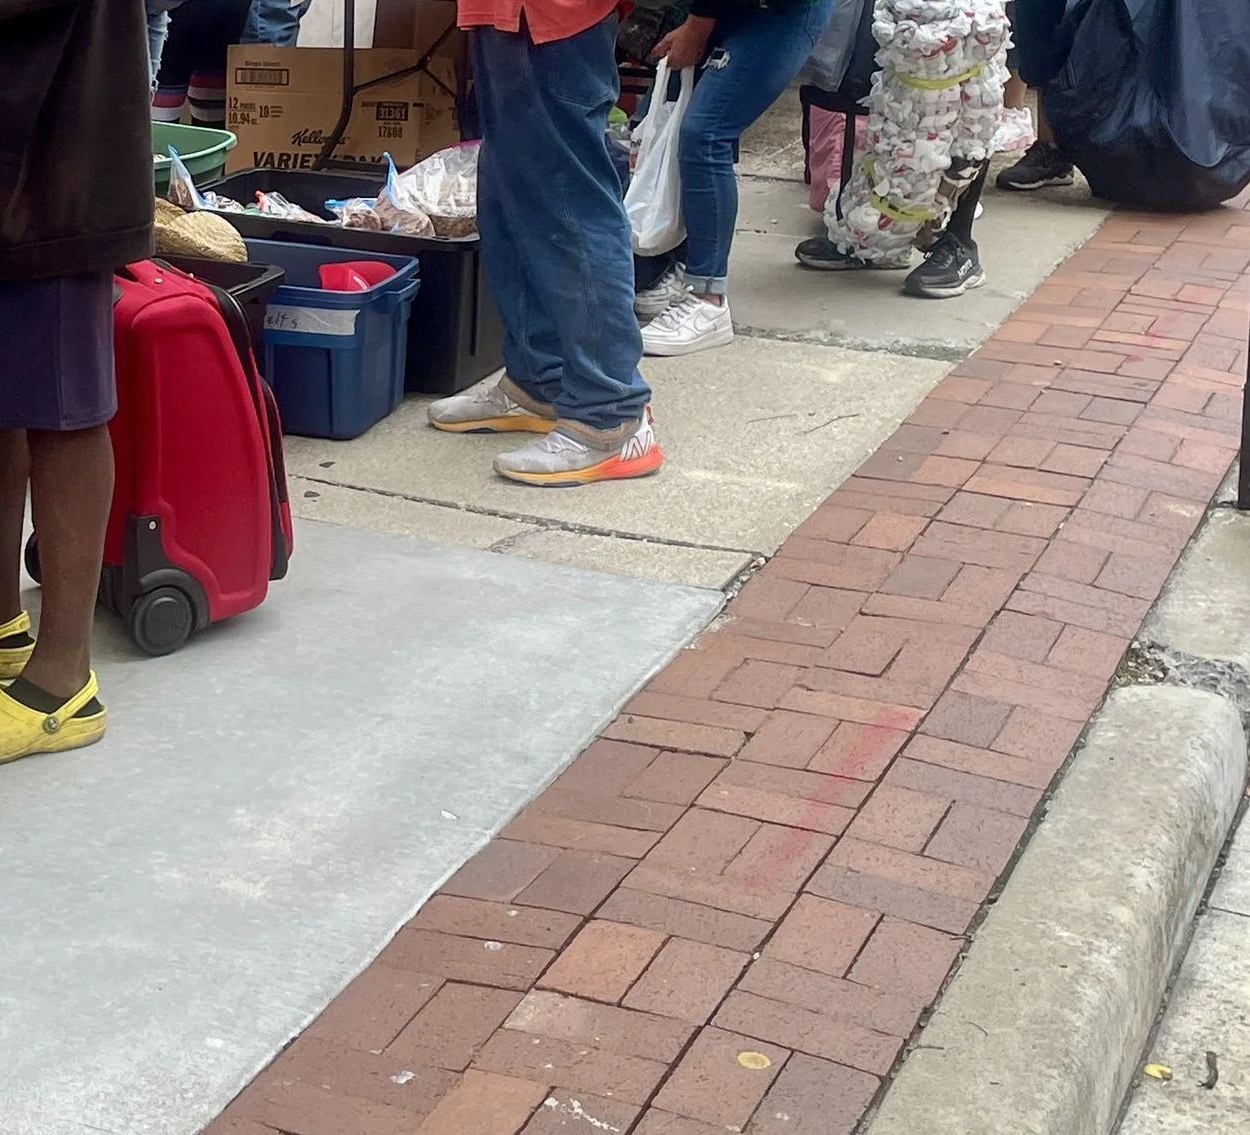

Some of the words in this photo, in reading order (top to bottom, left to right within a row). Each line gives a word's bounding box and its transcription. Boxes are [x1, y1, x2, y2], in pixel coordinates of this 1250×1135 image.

[228, 97, 238, 110] 12
[259, 105, 269, 118] 10
[228, 112, 251, 125] 10.94
